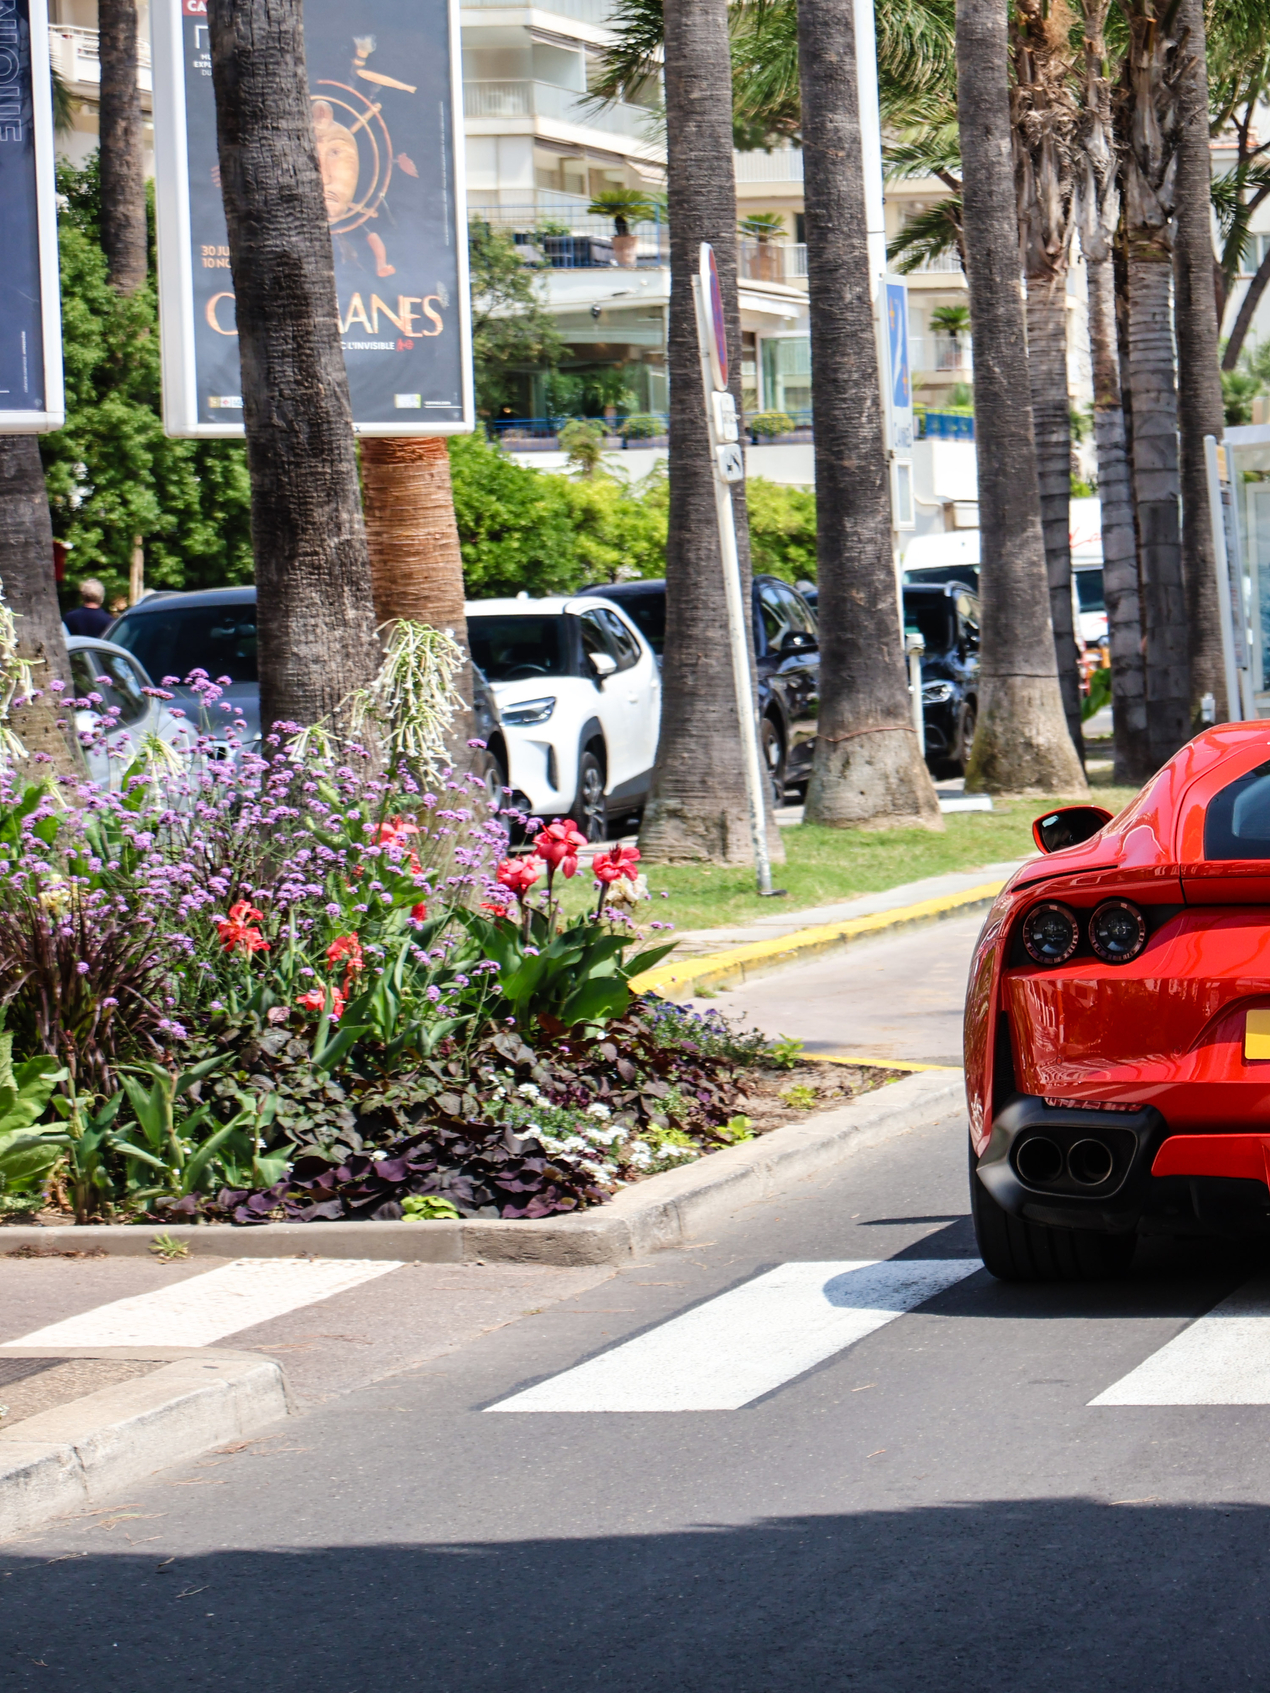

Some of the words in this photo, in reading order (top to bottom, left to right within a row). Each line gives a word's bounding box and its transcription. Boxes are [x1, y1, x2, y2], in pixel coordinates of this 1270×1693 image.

[201, 246, 215, 256] 30
[202, 258, 215, 268] 10
[336, 292, 444, 337] ANES
[348, 341, 395, 350] L'INVISIBLE
